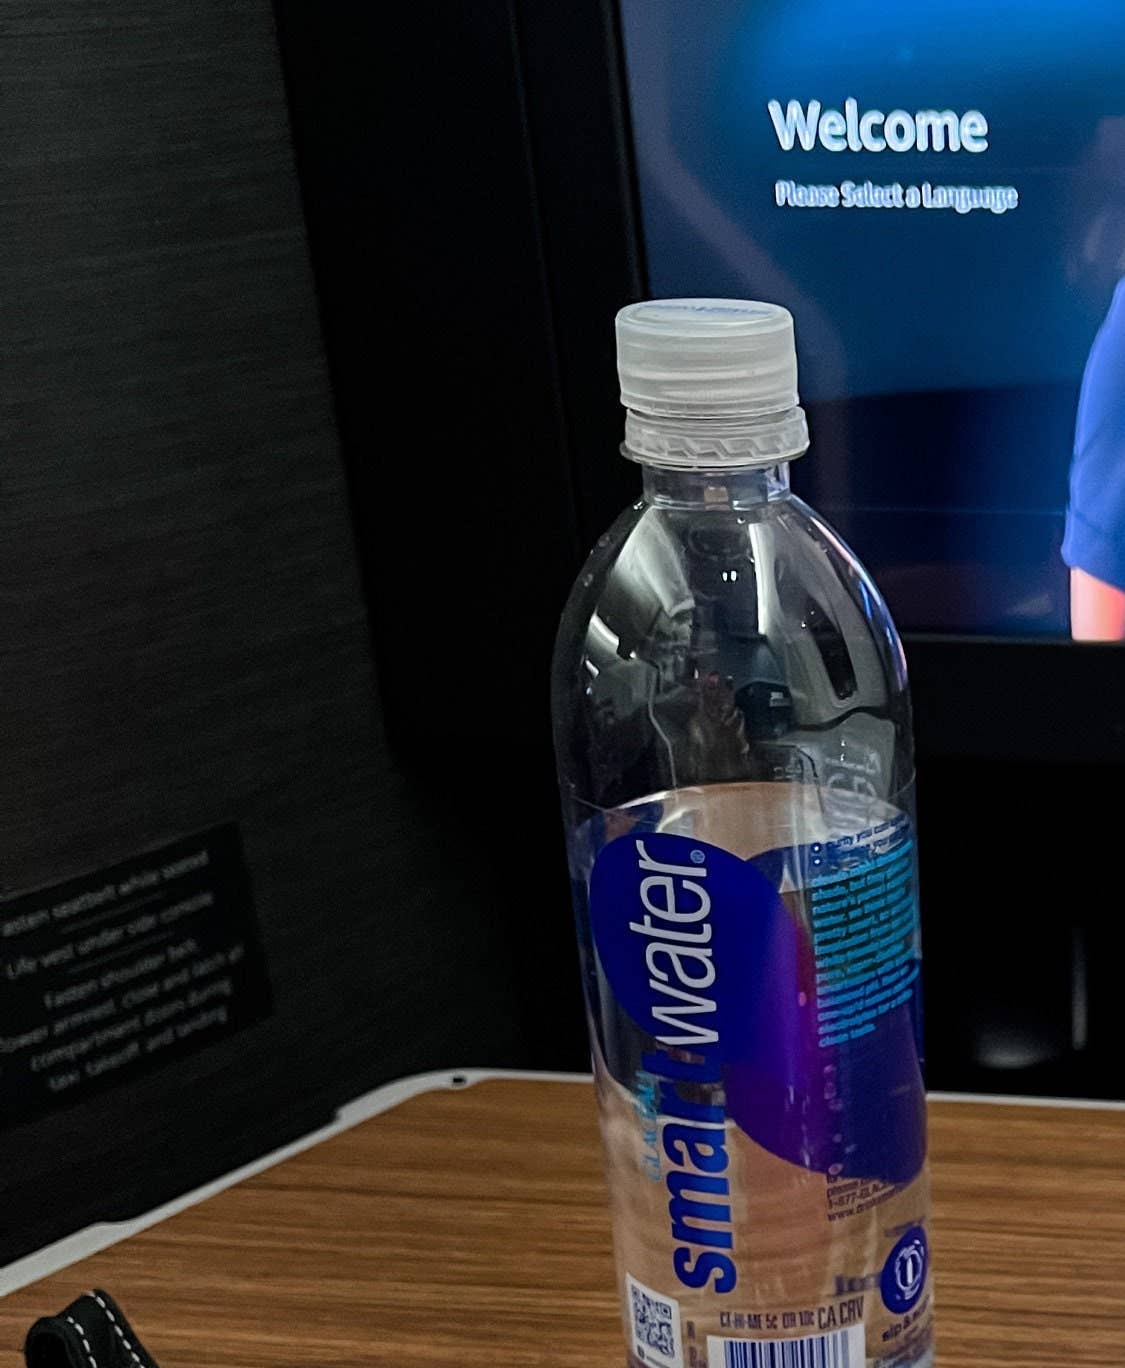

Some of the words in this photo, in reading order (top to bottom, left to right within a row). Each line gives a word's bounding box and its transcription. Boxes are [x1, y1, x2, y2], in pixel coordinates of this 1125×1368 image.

[767, 97, 988, 152] Welcome
[775, 179, 839, 207] Please
[840, 180, 904, 208] Select
[905, 185, 920, 208] a
[921, 181, 1018, 214] Language
[817, 1305, 836, 1330] CA
[839, 1296, 864, 1326] CRV
